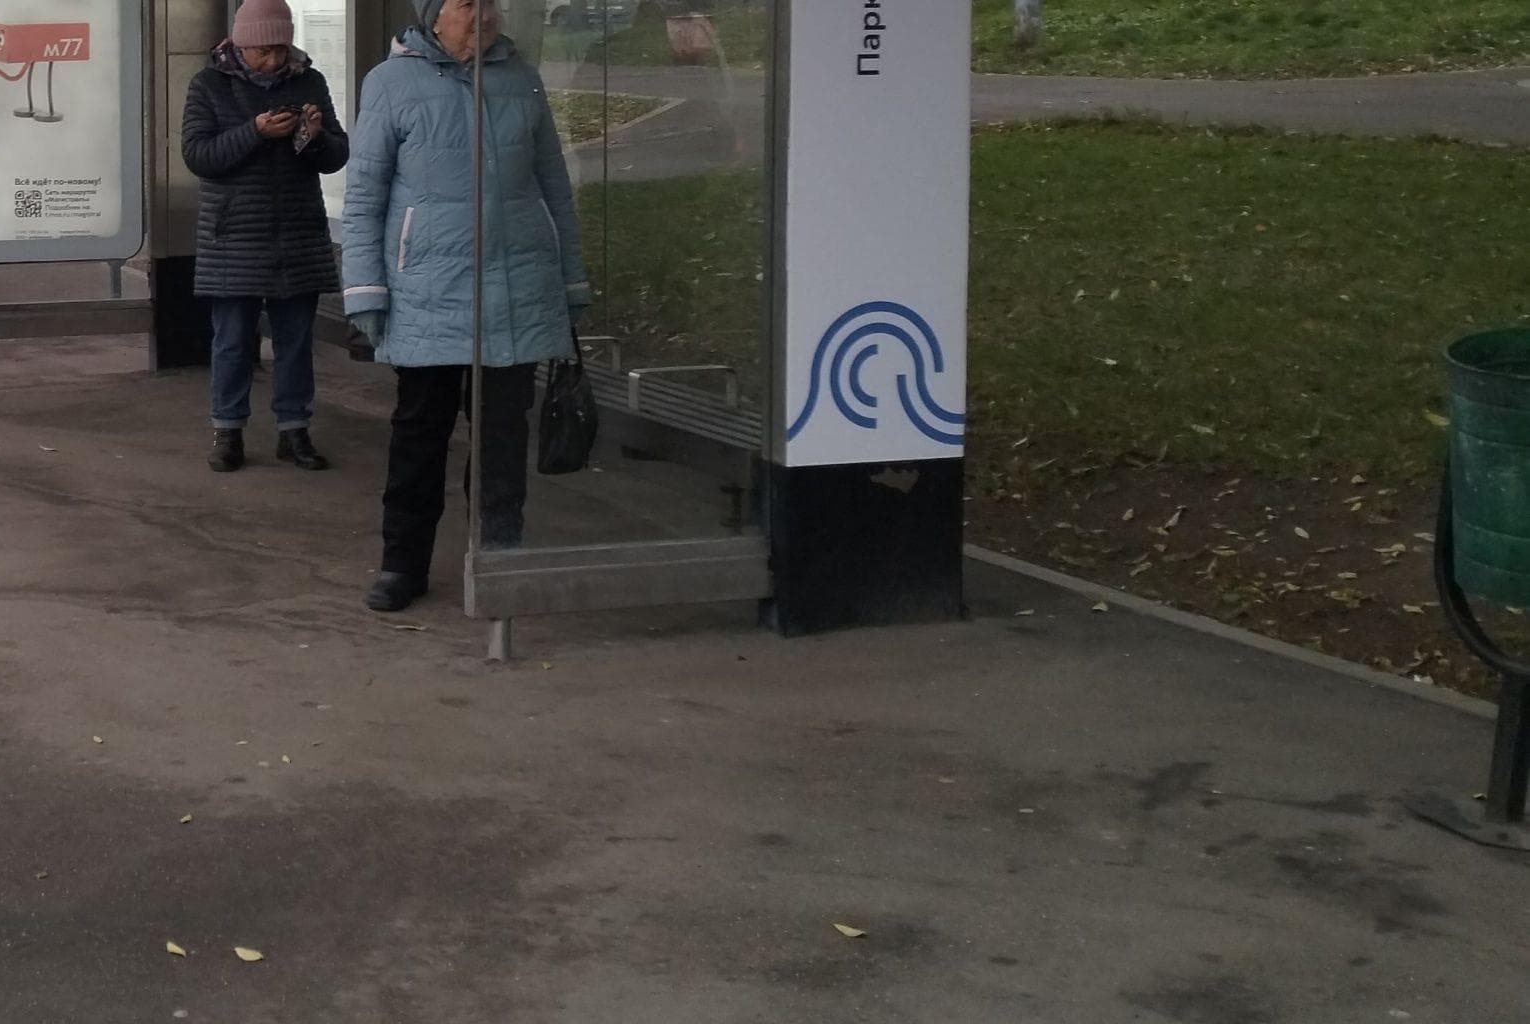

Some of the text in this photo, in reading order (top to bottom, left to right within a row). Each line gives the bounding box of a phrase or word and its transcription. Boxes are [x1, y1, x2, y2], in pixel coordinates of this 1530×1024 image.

[14, 177, 102, 187] Всё идёт по-новому!
